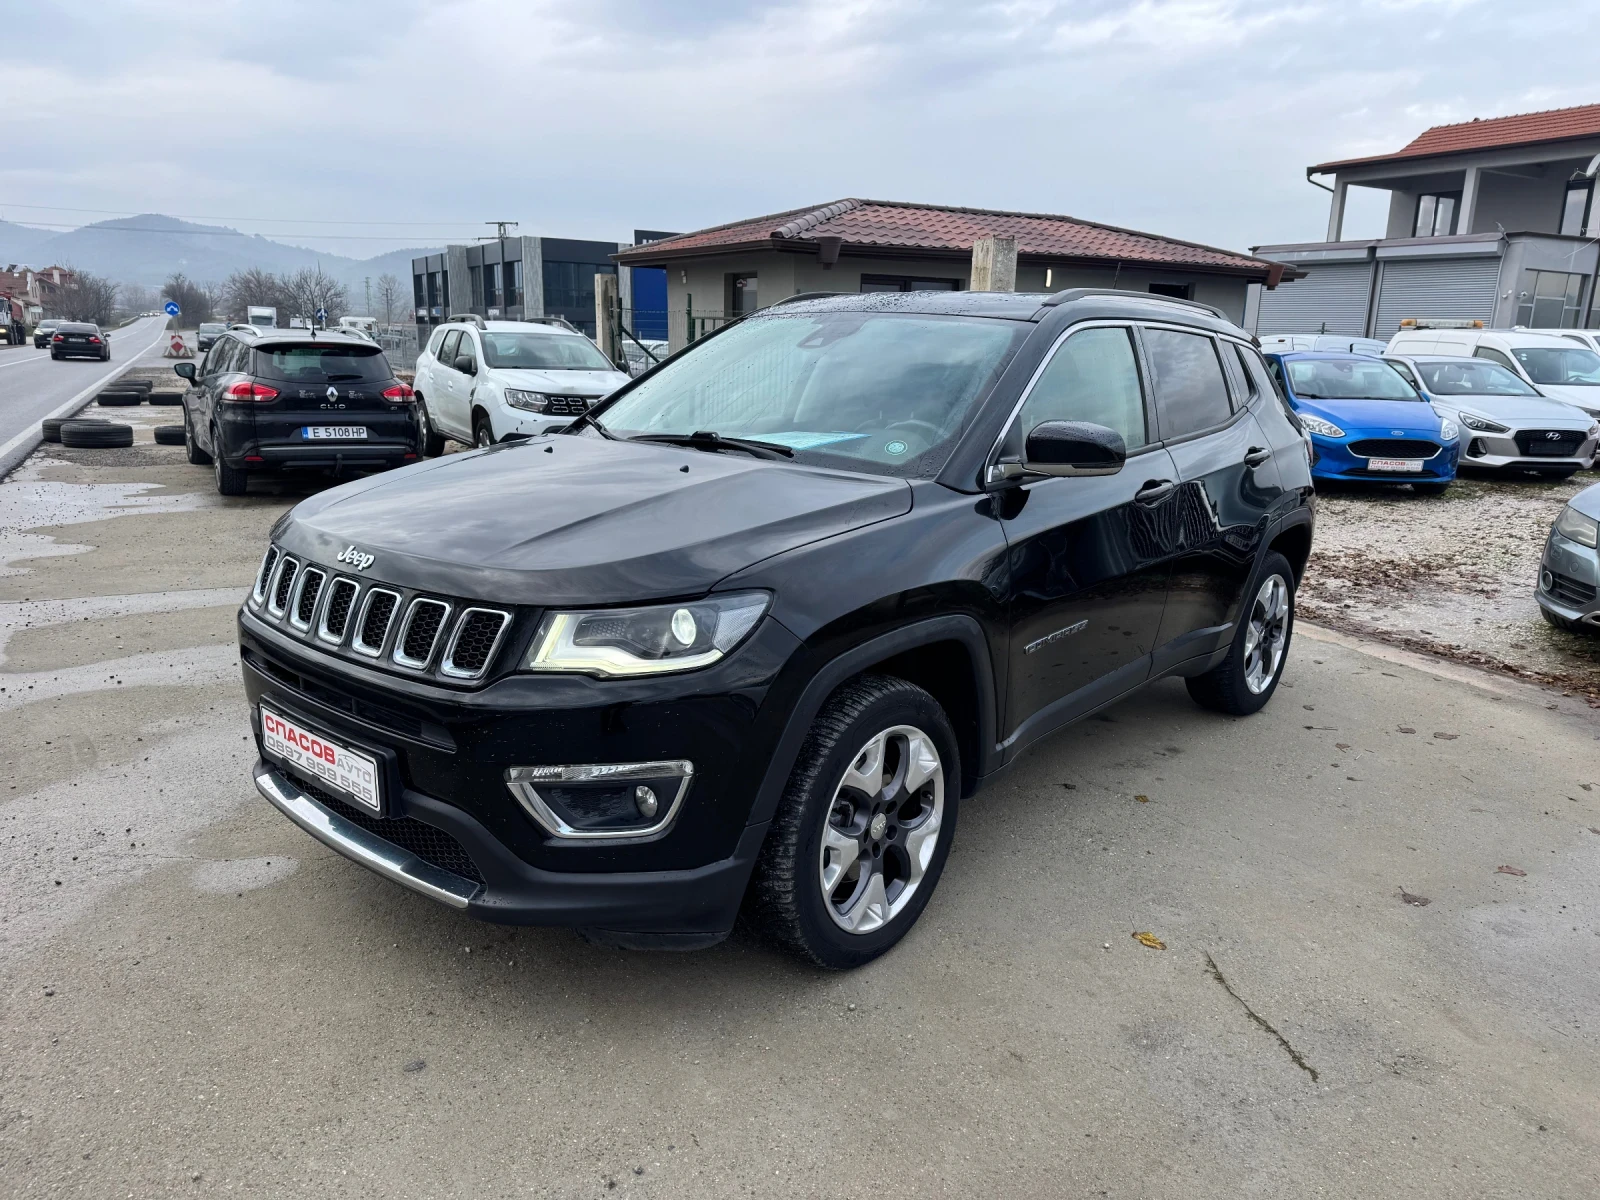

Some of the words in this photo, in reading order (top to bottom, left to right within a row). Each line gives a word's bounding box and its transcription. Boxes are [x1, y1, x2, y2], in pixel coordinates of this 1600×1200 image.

[313, 428, 320, 437] E
[325, 427, 350, 437] 5108
[337, 545, 375, 571] Jeep
[265, 715, 335, 765] СПАСОВ
[337, 758, 372, 785] АУТО
[267, 734, 303, 762] 0897
[306, 756, 338, 781] 999
[340, 774, 373, 802] 555
